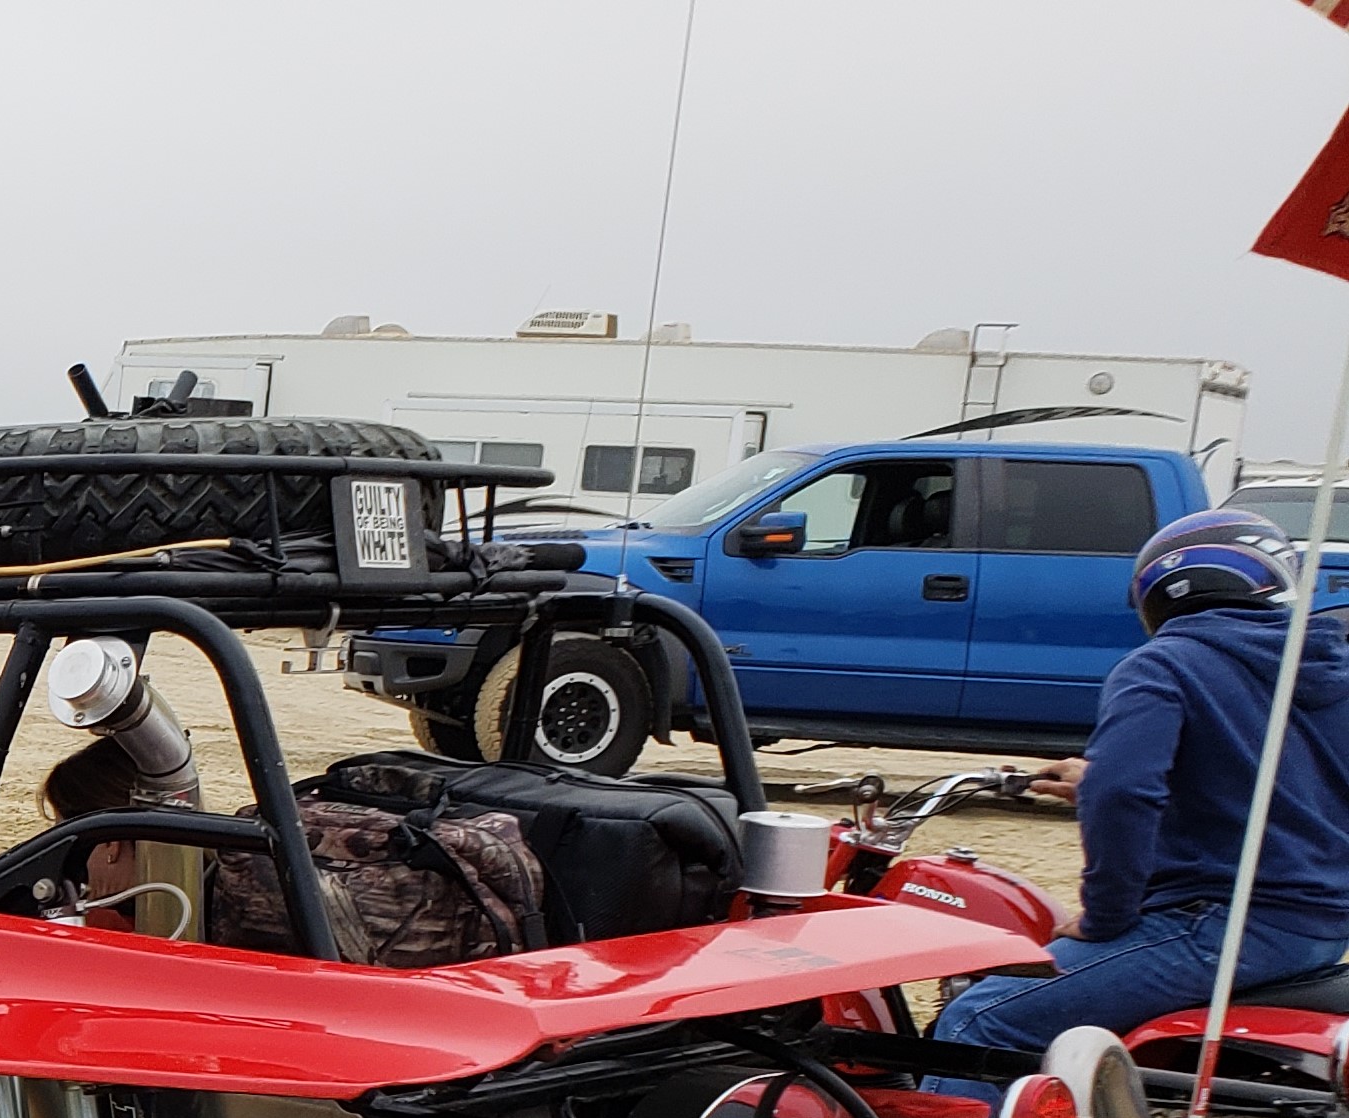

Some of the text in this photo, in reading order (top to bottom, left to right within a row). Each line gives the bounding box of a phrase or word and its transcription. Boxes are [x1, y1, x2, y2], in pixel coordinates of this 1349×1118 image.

[355, 485, 401, 516] GUILTY
[356, 516, 405, 530] OF BEING
[357, 530, 407, 561] WHITE
[901, 882, 968, 909] HONDA
